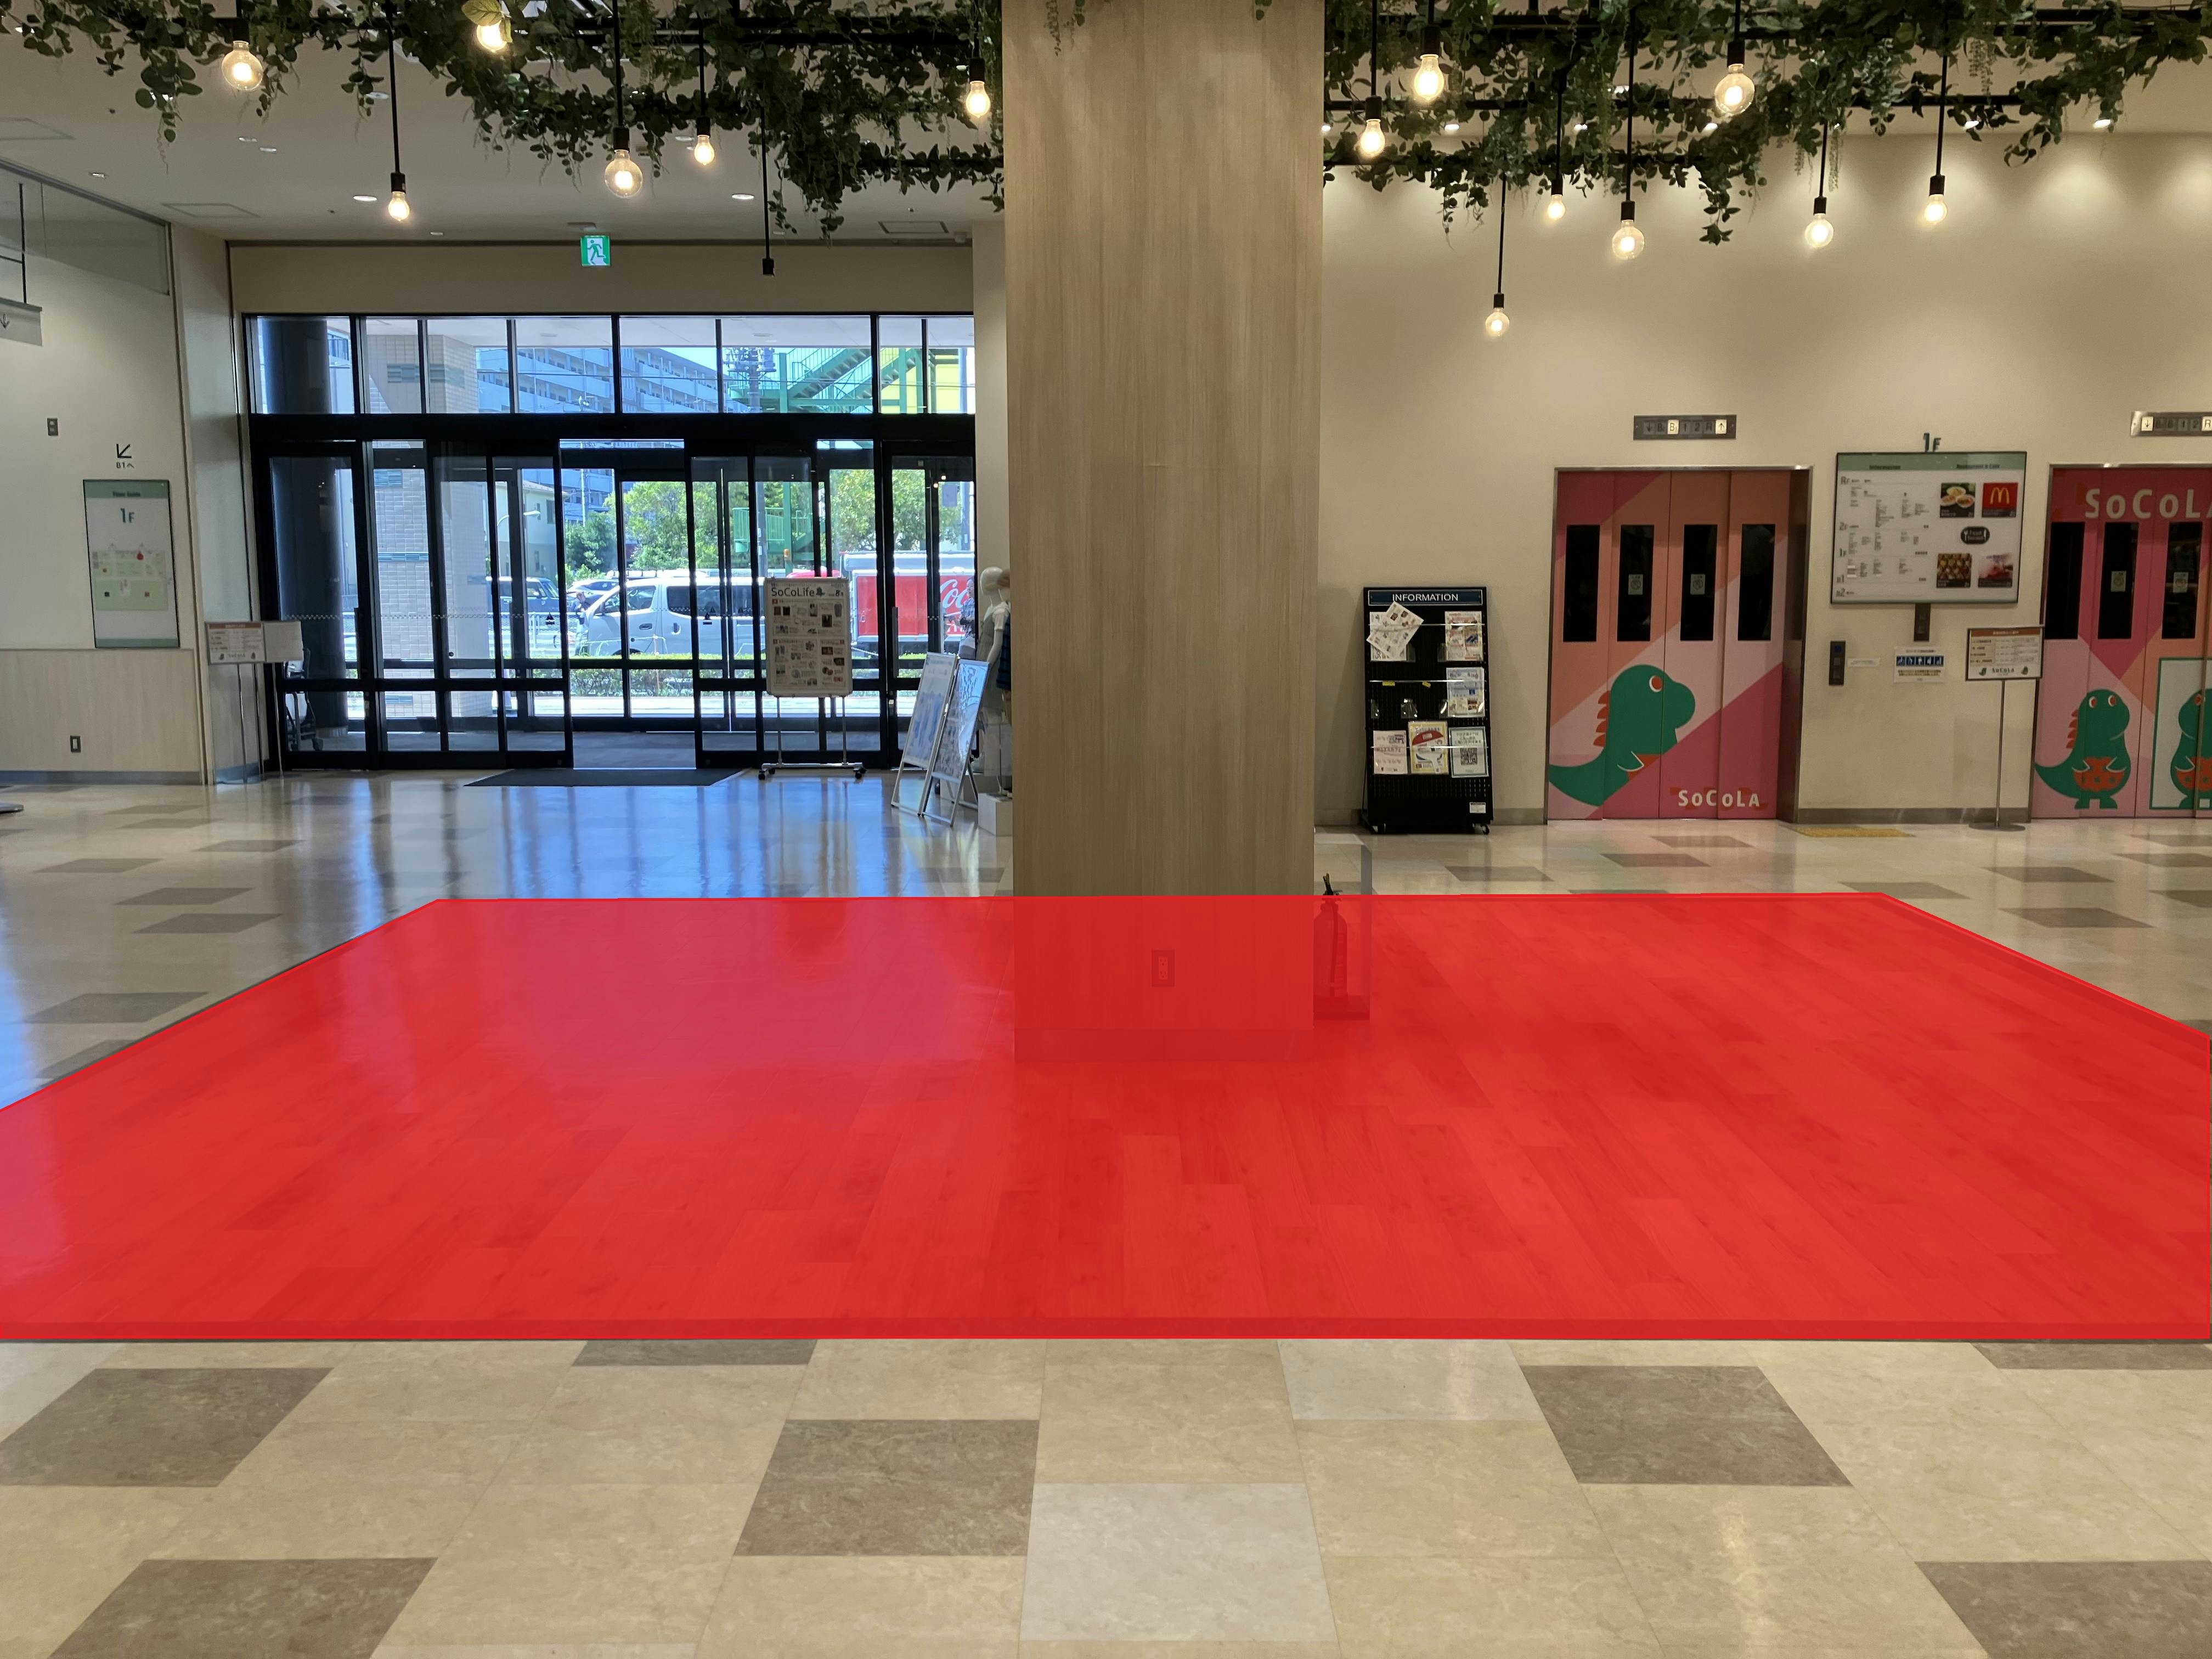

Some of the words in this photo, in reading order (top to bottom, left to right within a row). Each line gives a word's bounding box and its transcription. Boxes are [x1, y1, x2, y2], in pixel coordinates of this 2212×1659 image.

[1923, 432, 1942, 452] 1F
[2085, 488, 2212, 519] SoCoL
[120, 507, 135, 523] 1F
[771, 587, 815, 597] SoCoLife
[1392, 593, 1459, 602] INFORMATION
[1678, 789, 1760, 808] SoCoLA
